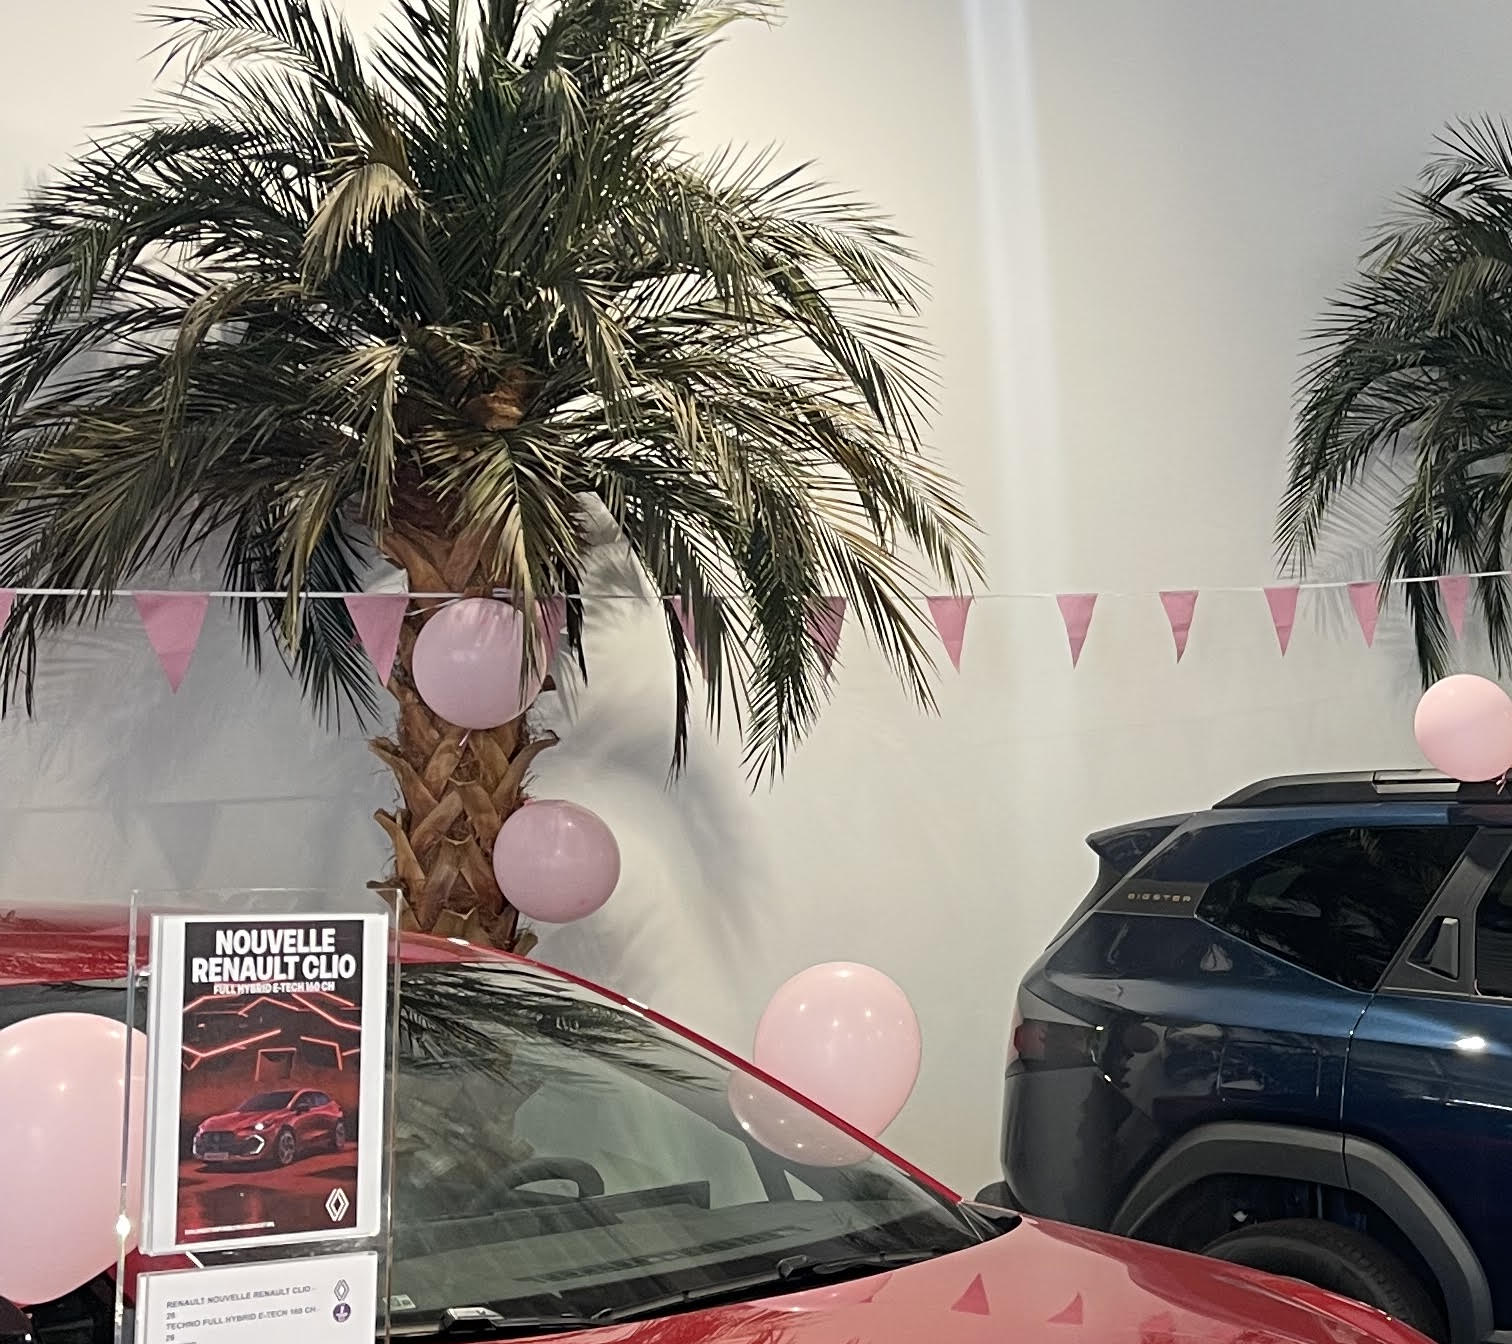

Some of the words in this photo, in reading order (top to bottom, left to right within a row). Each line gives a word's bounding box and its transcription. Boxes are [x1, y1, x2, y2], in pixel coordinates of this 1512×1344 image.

[1128, 893, 1192, 902] BIGSTER
[215, 928, 336, 955] NOUVELLE
[192, 955, 300, 983] RENAULT
[302, 954, 357, 979] CLIO
[213, 982, 236, 995] FULL
[237, 982, 272, 995] HYBRID
[272, 981, 304, 993] E-TECH
[322, 981, 335, 992] CH
[166, 1297, 205, 1308] RENAULT
[207, 1291, 251, 1304] NOUVELLE
[252, 1287, 290, 1298] RENAULT
[202, 1317, 223, 1327] FULL
[225, 1313, 257, 1323] HYBRID
[258, 1310, 288, 1320] E-TECH
